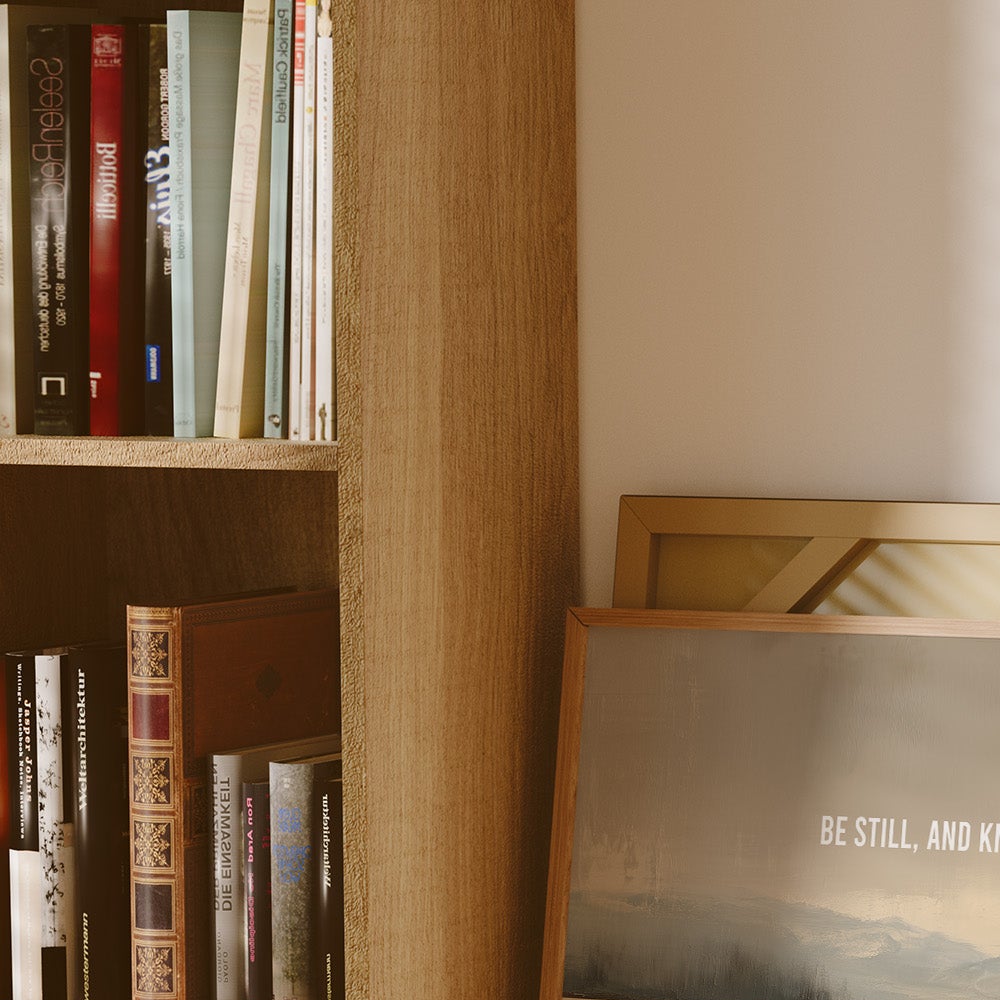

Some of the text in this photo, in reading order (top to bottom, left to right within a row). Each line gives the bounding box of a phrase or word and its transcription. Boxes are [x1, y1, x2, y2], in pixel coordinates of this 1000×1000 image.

[22, 700, 34, 802] Jasper Johns
[78, 669, 87, 812] Weltarchitektur
[820, 815, 848, 846] BE
[854, 817, 919, 853] STILL,
[927, 820, 971, 852] AND
